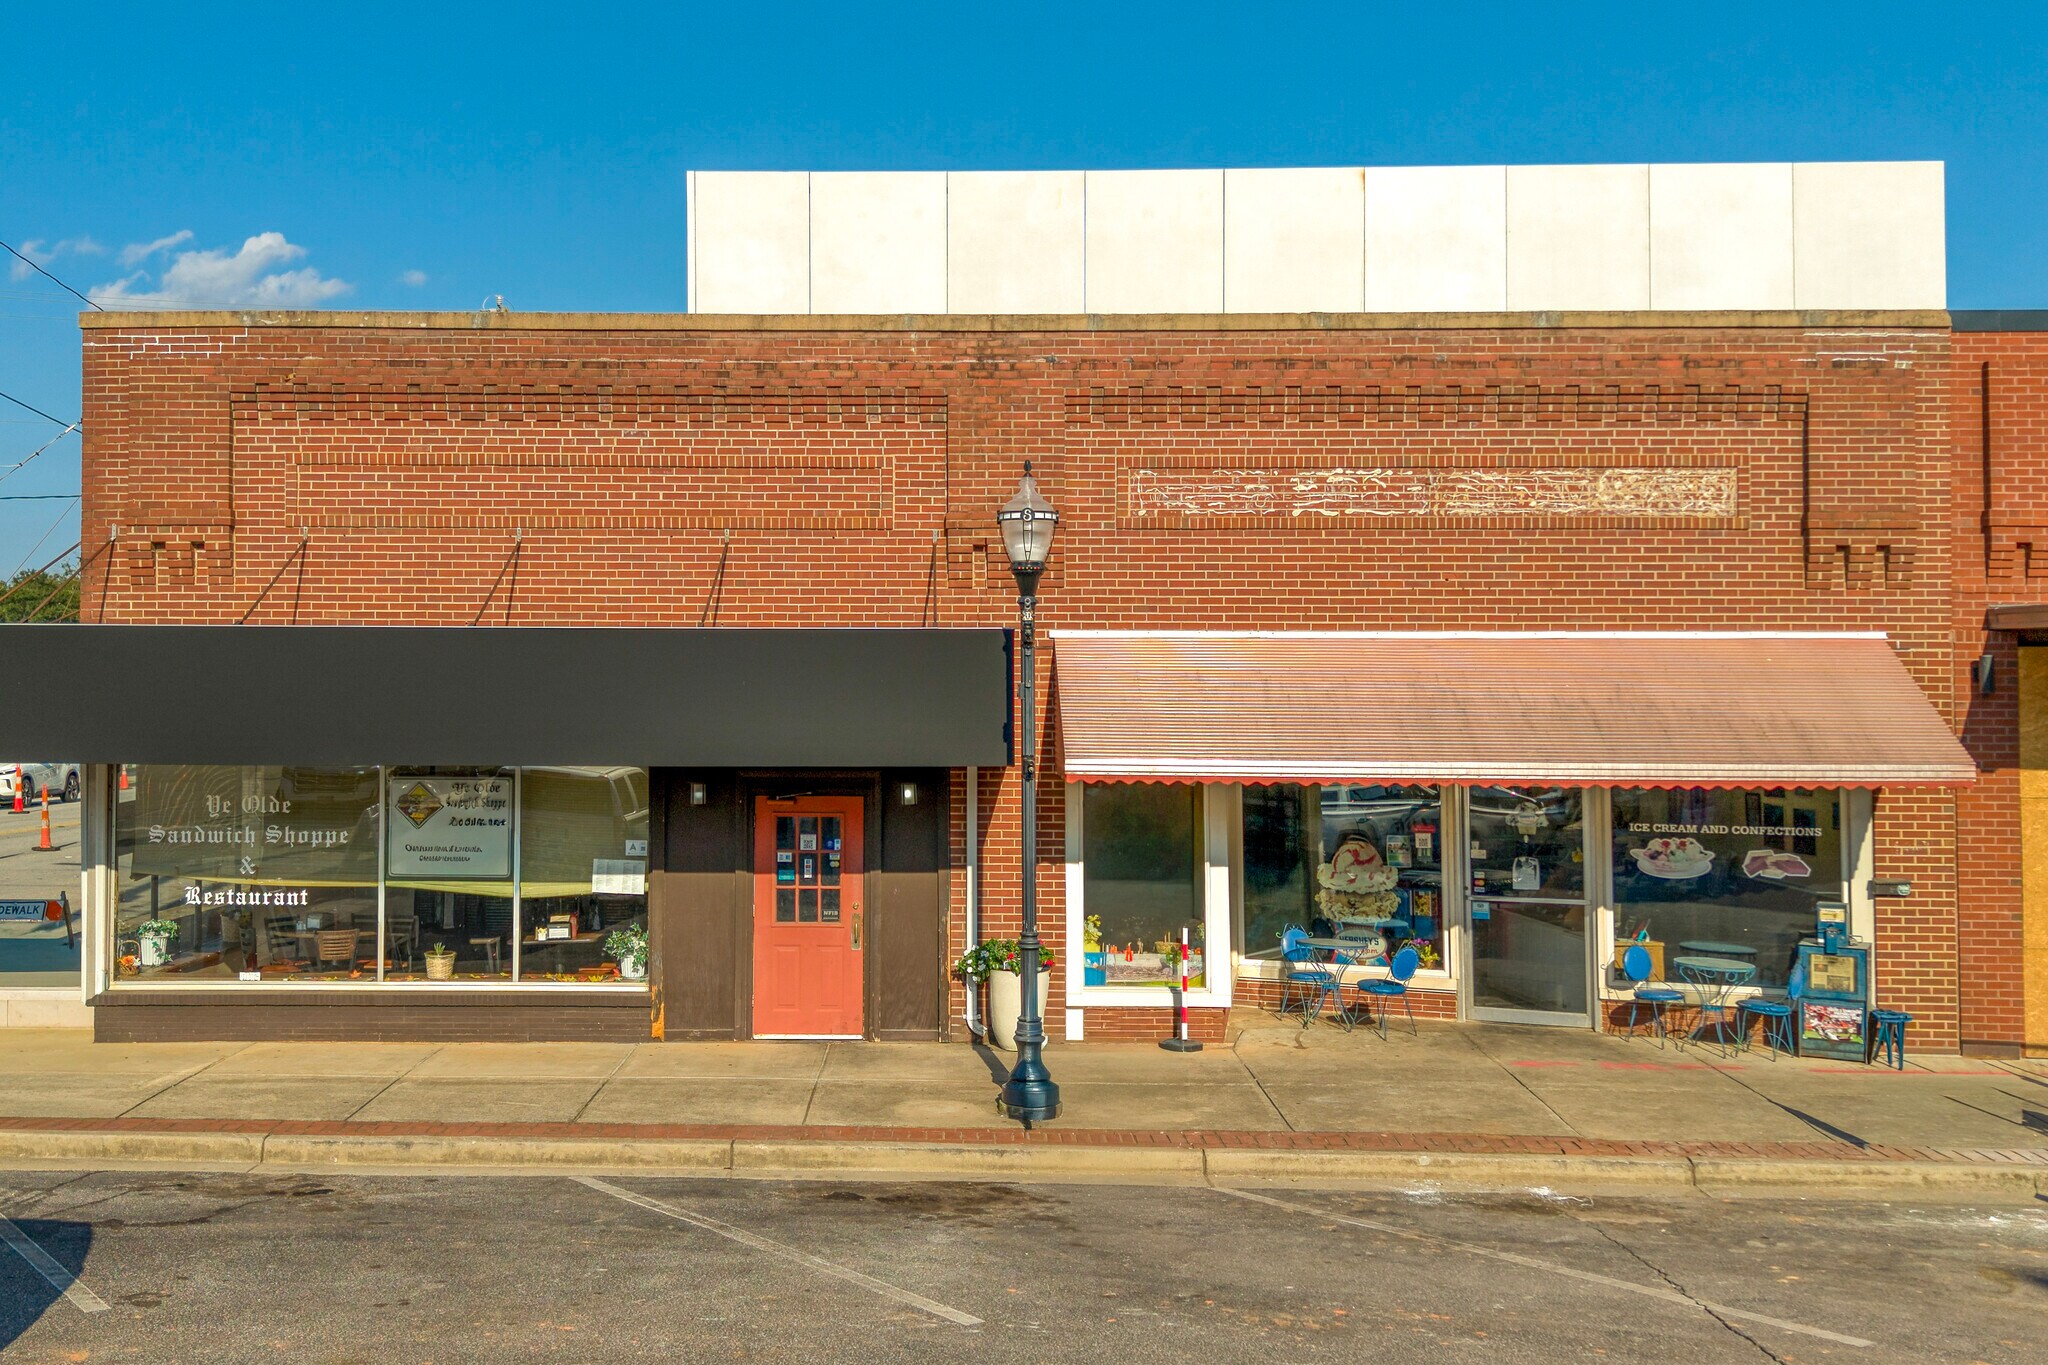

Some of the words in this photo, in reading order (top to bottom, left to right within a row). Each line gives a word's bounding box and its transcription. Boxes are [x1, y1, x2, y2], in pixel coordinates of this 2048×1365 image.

[206, 794, 231, 818] Ye
[241, 795, 292, 814] Olde
[148, 824, 256, 848] Sandwich
[265, 824, 349, 848] Shoppe
[1629, 823, 1650, 832] ICE
[1653, 823, 1698, 834] CREAM
[1700, 825, 1729, 835] AND
[1731, 826, 1822, 837] CONFECTIONS
[629, 843, 637, 851] A
[239, 855, 256, 875] &
[184, 886, 308, 906] Restaurant
